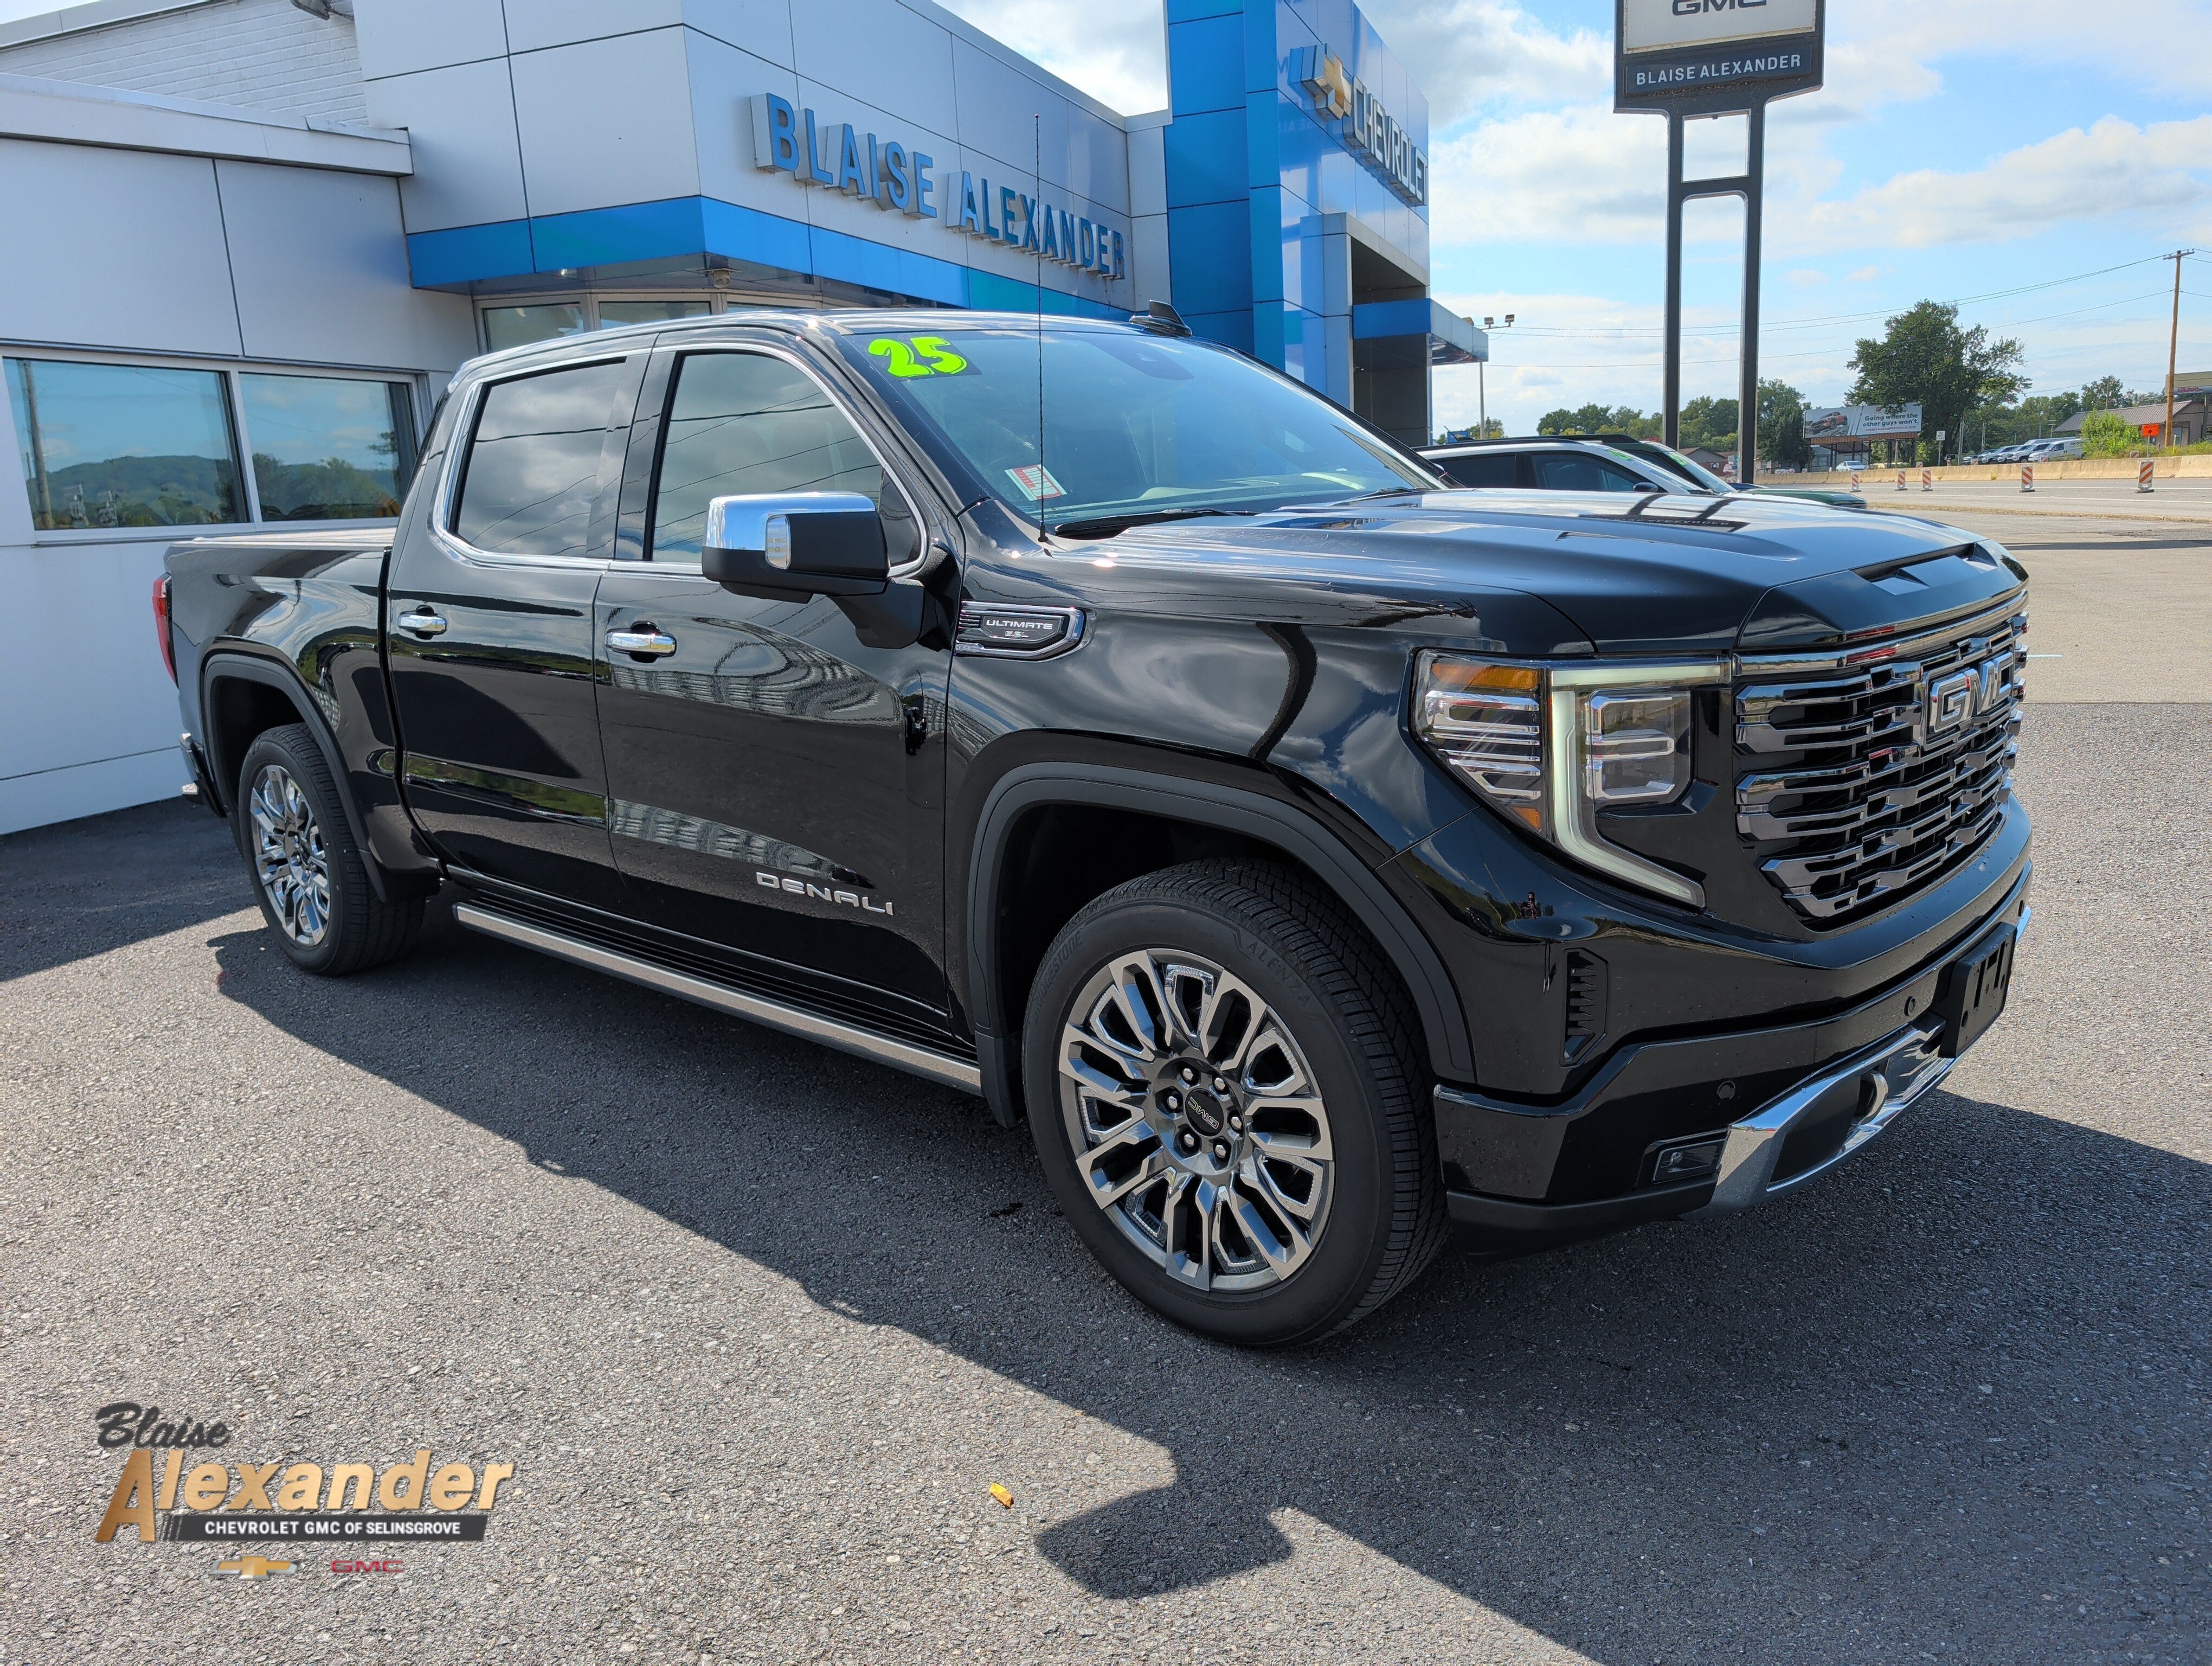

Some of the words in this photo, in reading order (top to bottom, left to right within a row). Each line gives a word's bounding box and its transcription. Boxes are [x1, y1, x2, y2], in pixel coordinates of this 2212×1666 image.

[1637, 66, 1695, 85] BLAISE
[1700, 54, 1801, 78] ALEXANDER
[1353, 75, 1428, 206] CHEVROLET
[766, 93, 937, 218] BLAISE
[959, 171, 1126, 280] ALEXANDER
[868, 337, 968, 377] 25
[986, 619, 1053, 629] ULTIMATE
[1930, 651, 2014, 733] GMC
[756, 872, 894, 916] DENALI
[1246, 941, 1311, 1007] ALENZA
[1187, 1096, 1219, 1129] GMC
